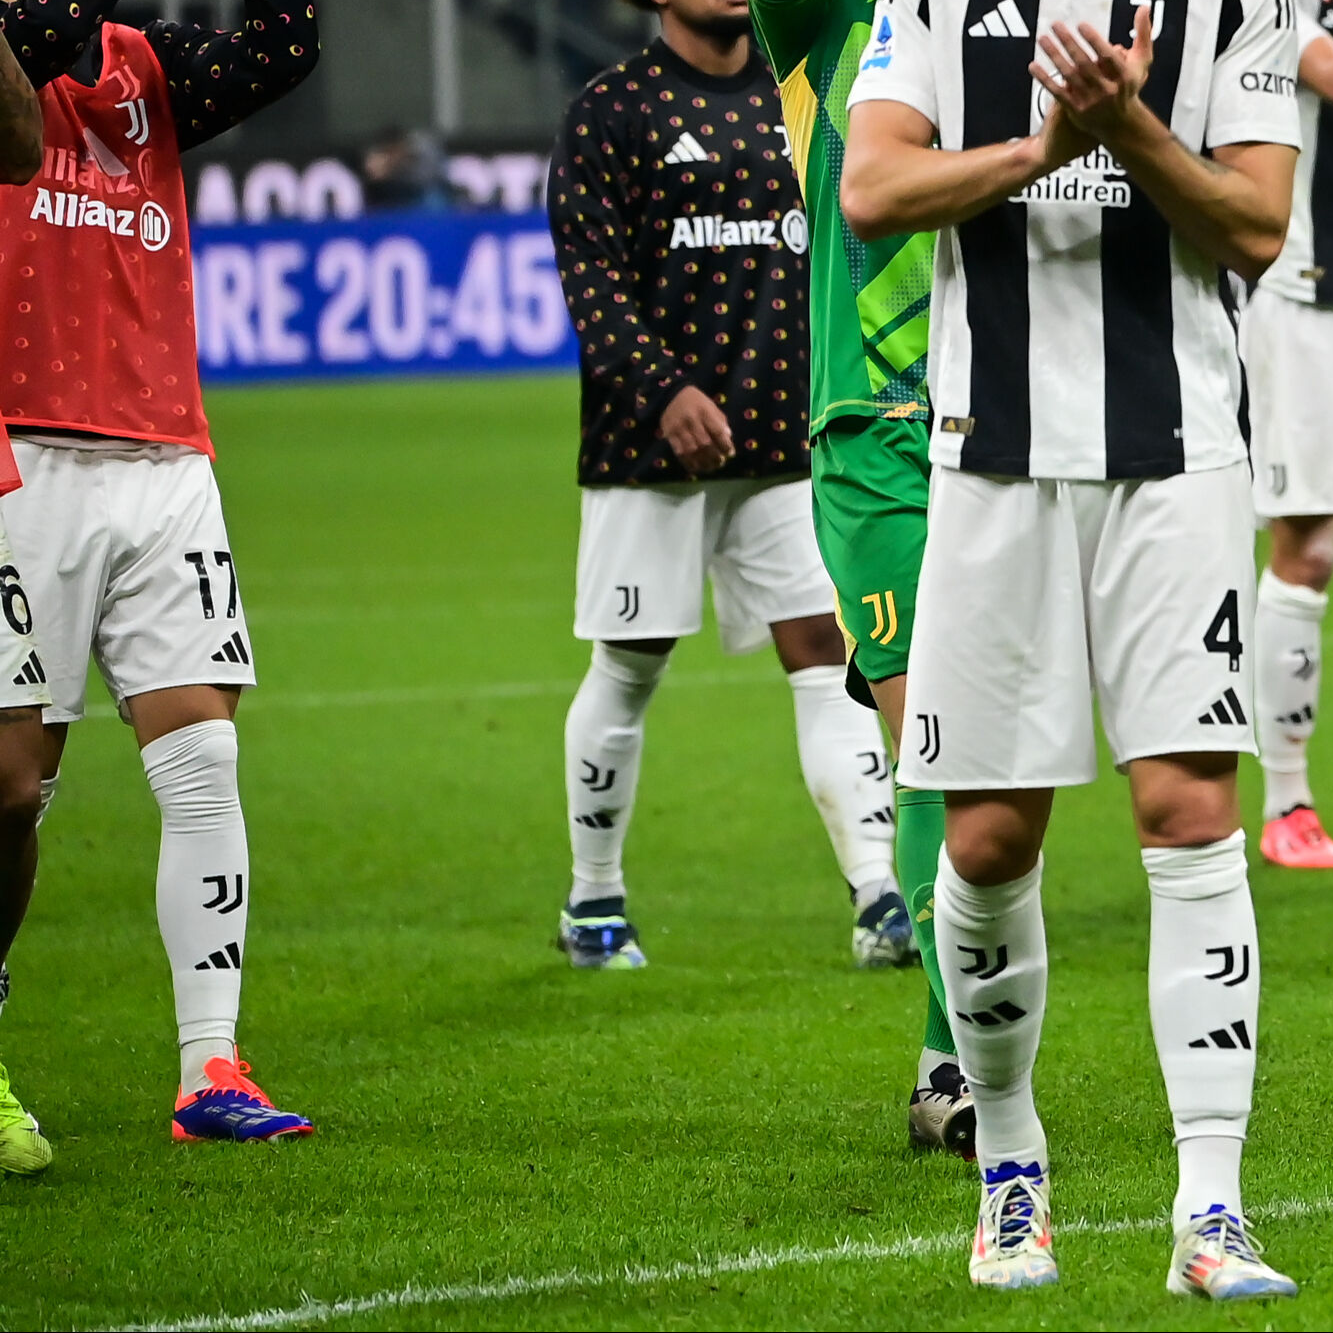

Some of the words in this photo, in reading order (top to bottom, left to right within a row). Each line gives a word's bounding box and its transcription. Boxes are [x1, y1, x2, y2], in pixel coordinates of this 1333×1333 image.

[30, 186, 135, 237] Allianz
[1027, 174, 1127, 204] hildren
[669, 214, 778, 250] Allianz
[194, 239, 310, 367] RE
[315, 232, 567, 363] 20:45
[184, 550, 238, 620] 17
[1203, 588, 1243, 672] 4
